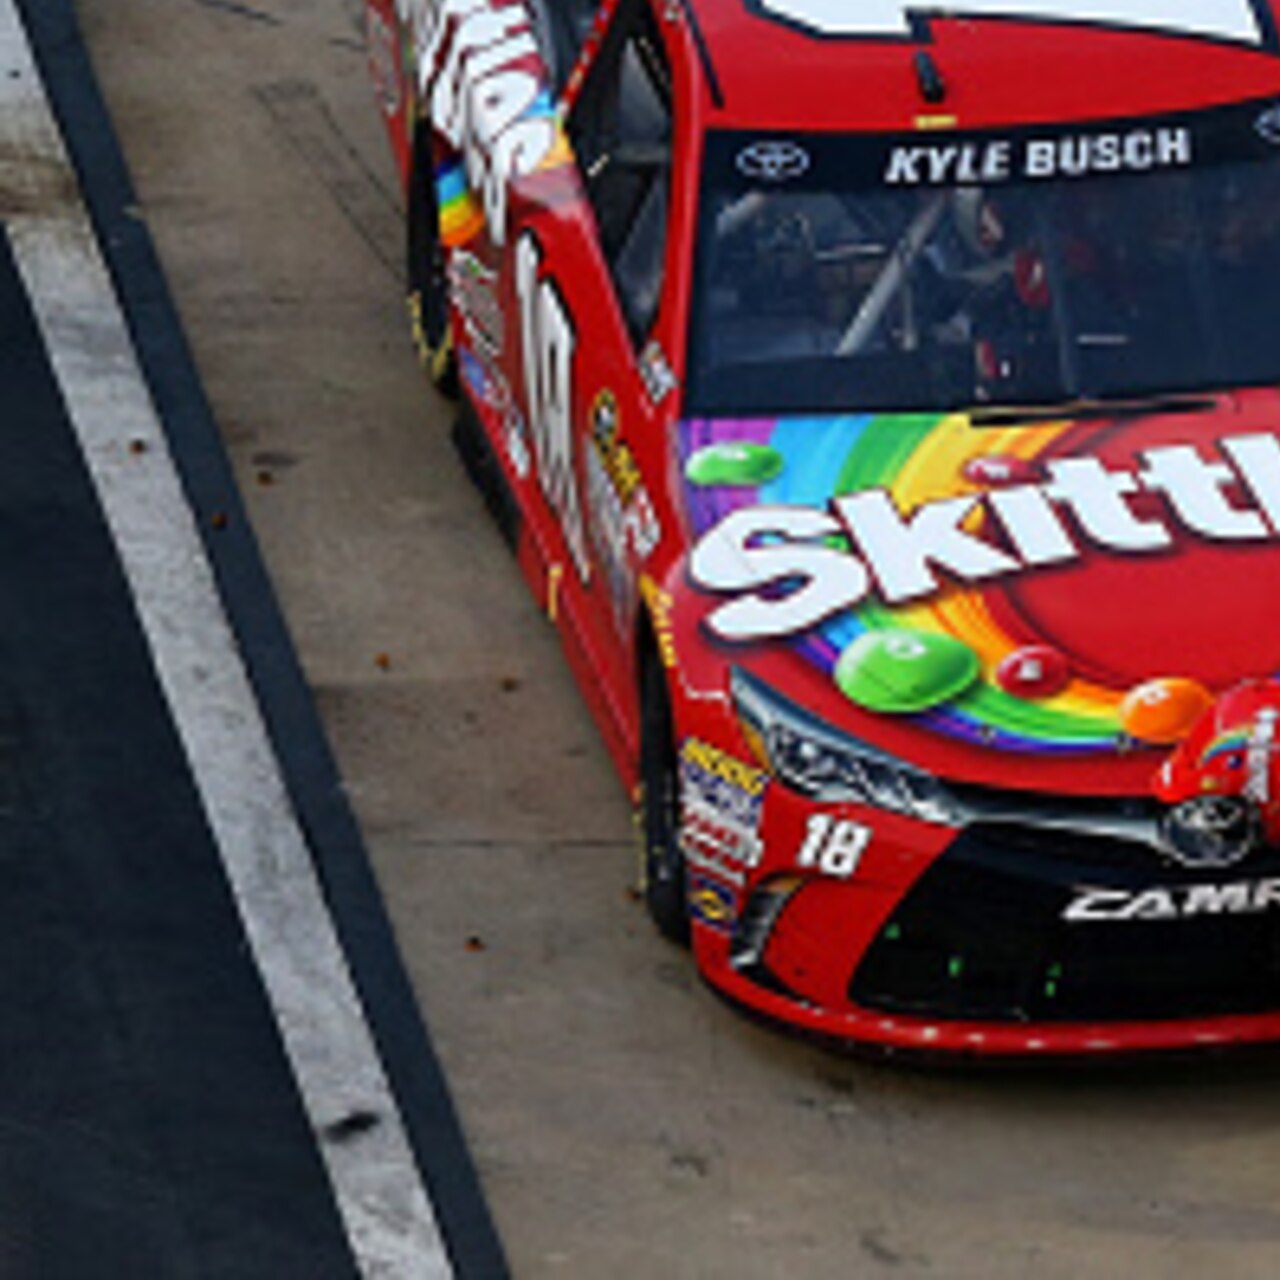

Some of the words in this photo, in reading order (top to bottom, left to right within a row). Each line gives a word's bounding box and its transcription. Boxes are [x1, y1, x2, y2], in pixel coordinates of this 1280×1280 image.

[885, 140, 1010, 183] KYLE
[1026, 127, 1190, 176] BUSCH
[798, 813, 873, 877] 18
